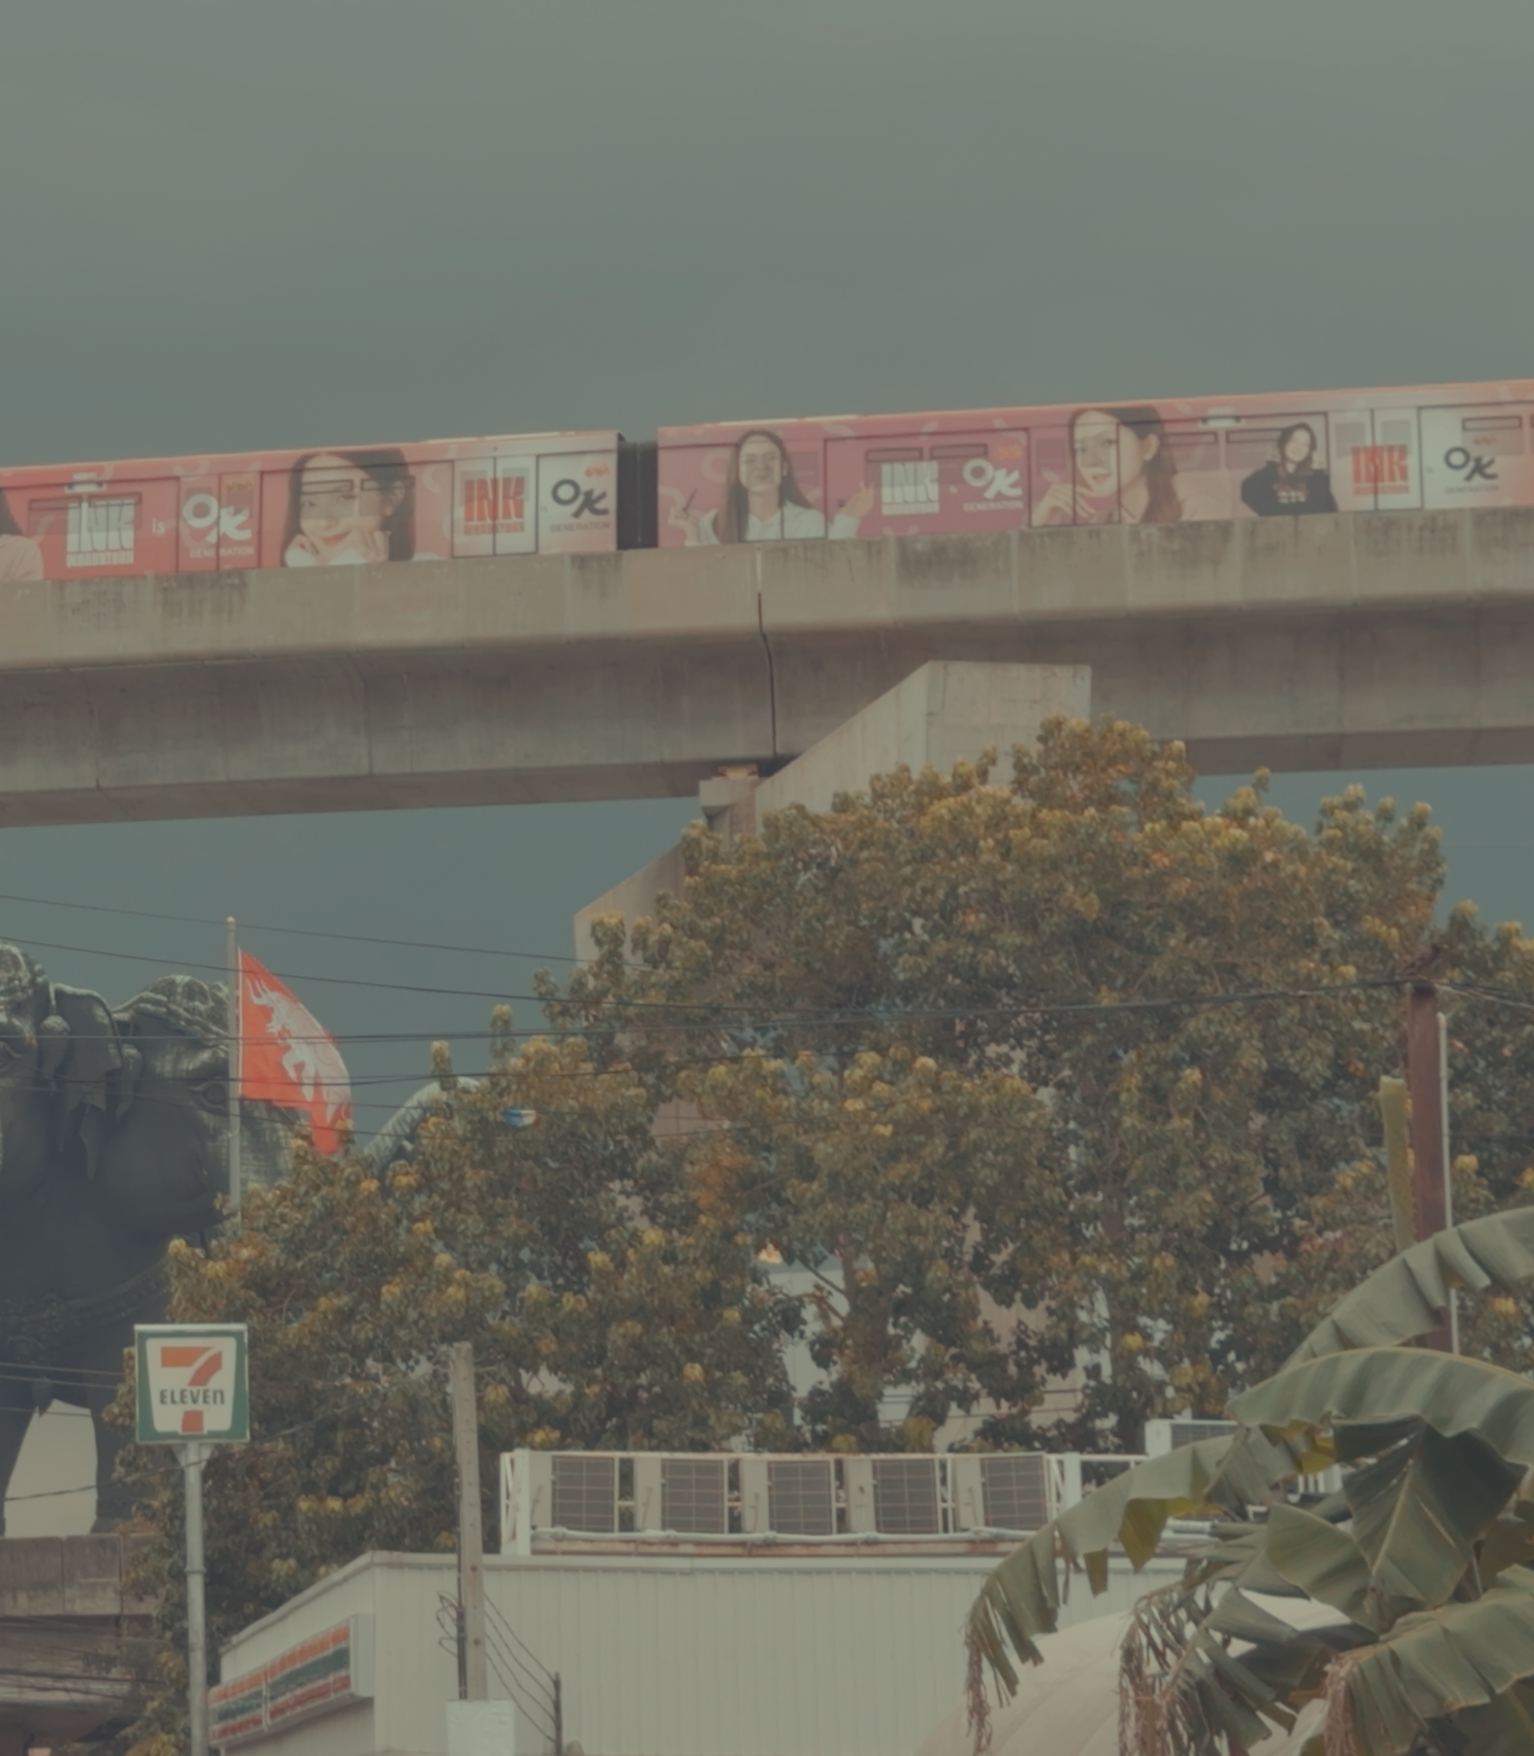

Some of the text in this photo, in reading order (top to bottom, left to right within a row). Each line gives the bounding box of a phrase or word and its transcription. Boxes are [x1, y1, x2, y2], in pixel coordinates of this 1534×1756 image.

[464, 477, 524, 521] INK
[67, 499, 166, 553] INK is
